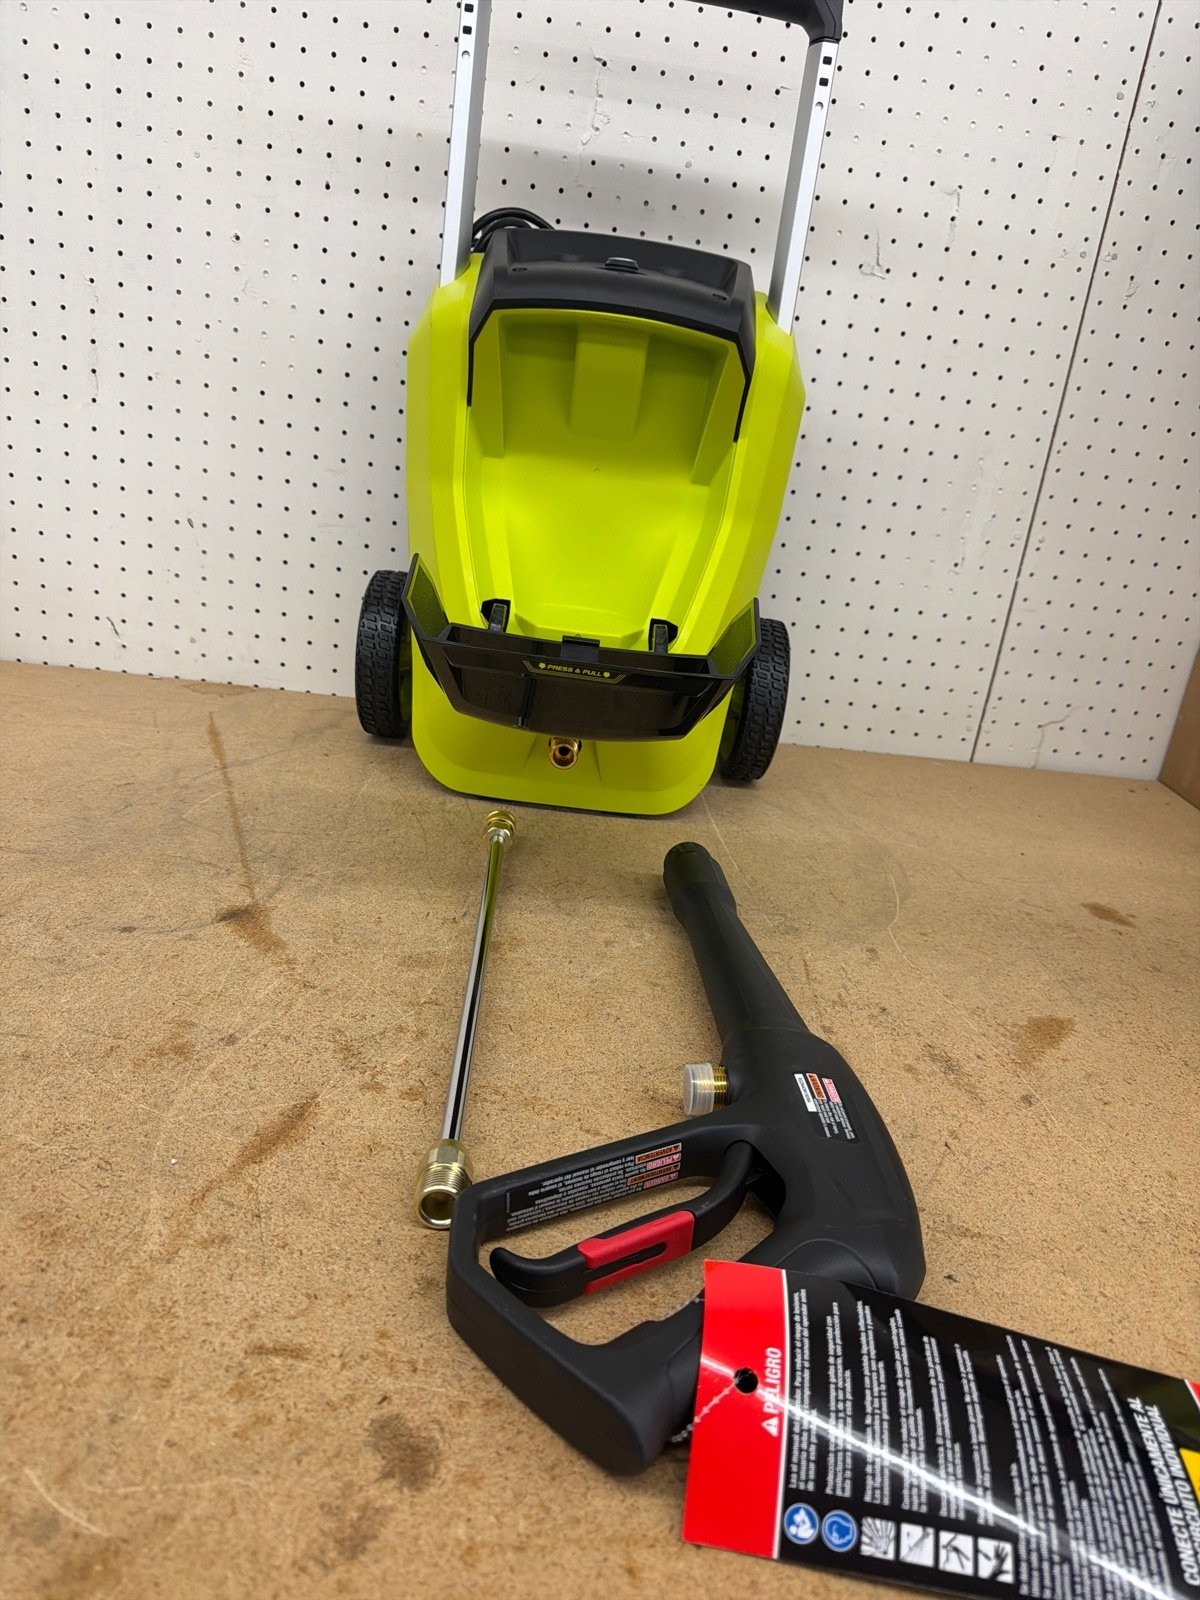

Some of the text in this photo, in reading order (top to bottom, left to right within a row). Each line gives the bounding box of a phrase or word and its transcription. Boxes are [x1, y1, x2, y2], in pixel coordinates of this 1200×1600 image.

[547, 664, 574, 673] PRESS
[582, 669, 602, 677] PULL
[801, 1303, 809, 1327] operador
[826, 1326, 835, 1356] seguridad
[833, 1314, 842, 1344] protección
[828, 1365, 836, 1383] gafas
[837, 1401, 843, 1410] de
[790, 1464, 797, 1472] el
[825, 1452, 834, 1495] Protección
[1127, 1396, 1200, 1586] CONECTE ÚNICAMENTE AL
[1146, 1404, 1200, 1570] CIRCUITO INDIVIDUAL
